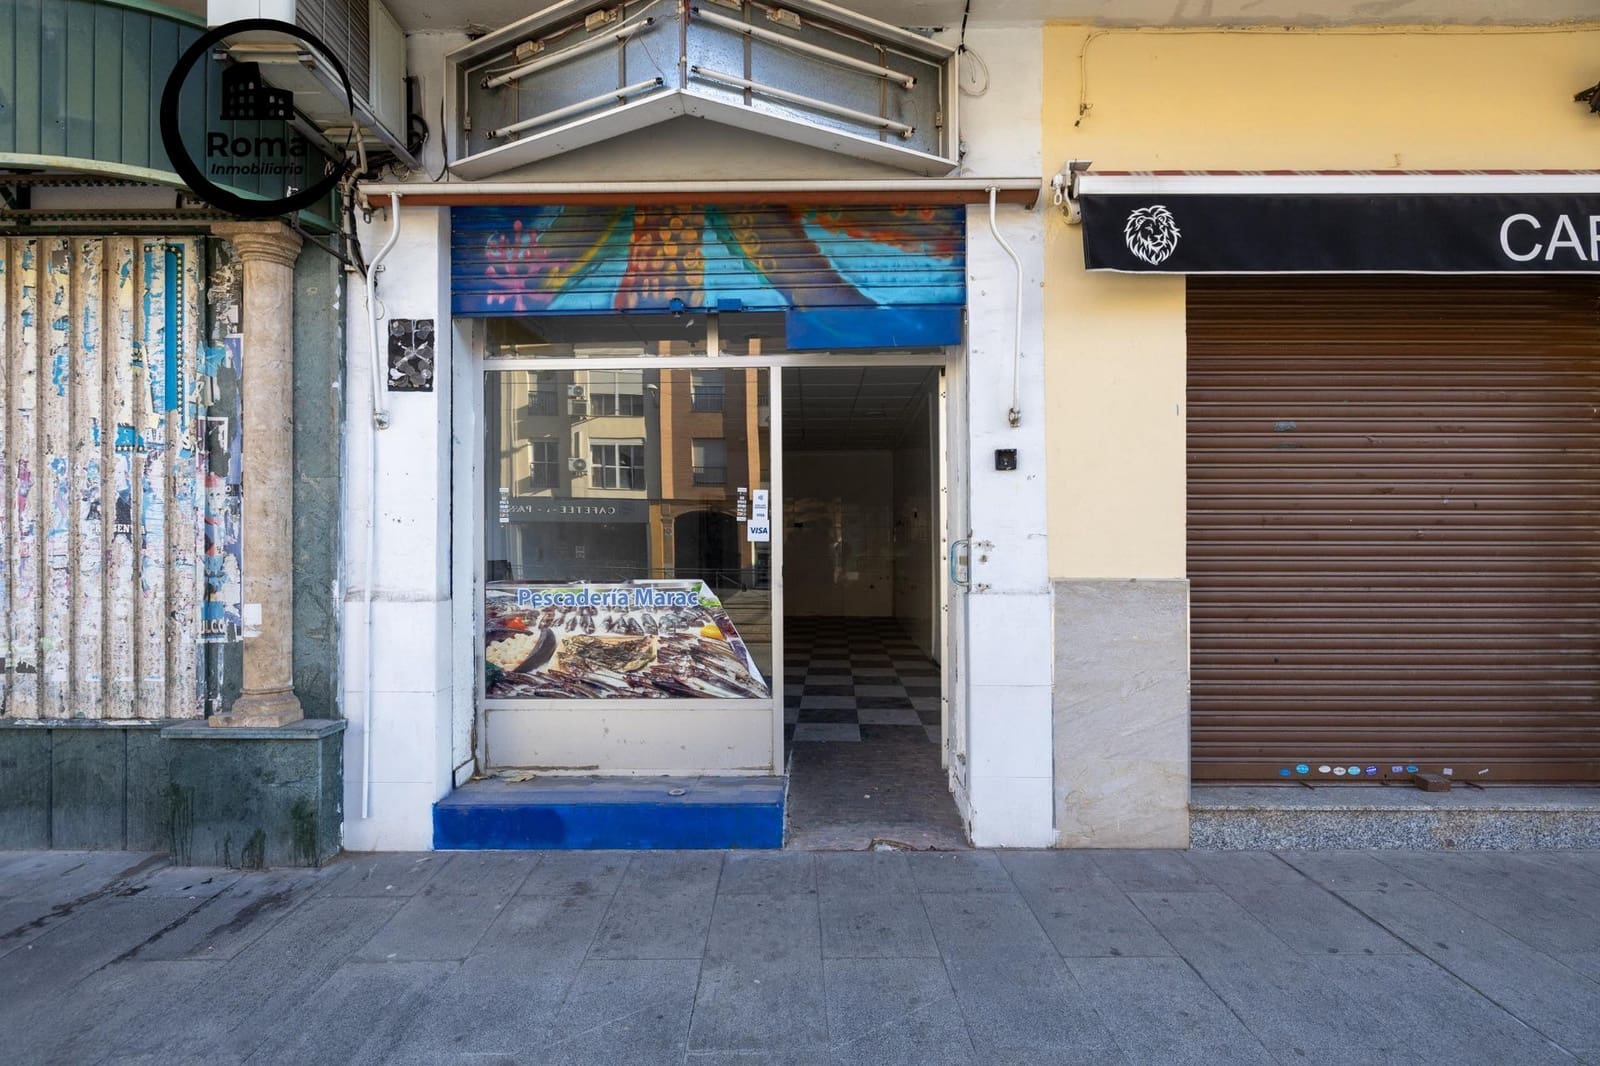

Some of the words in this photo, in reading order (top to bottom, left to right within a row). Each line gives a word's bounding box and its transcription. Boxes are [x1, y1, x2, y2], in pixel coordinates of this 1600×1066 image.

[750, 527, 768, 535] VISA
[518, 587, 629, 606] Pescadería
[635, 588, 699, 606] Marac
